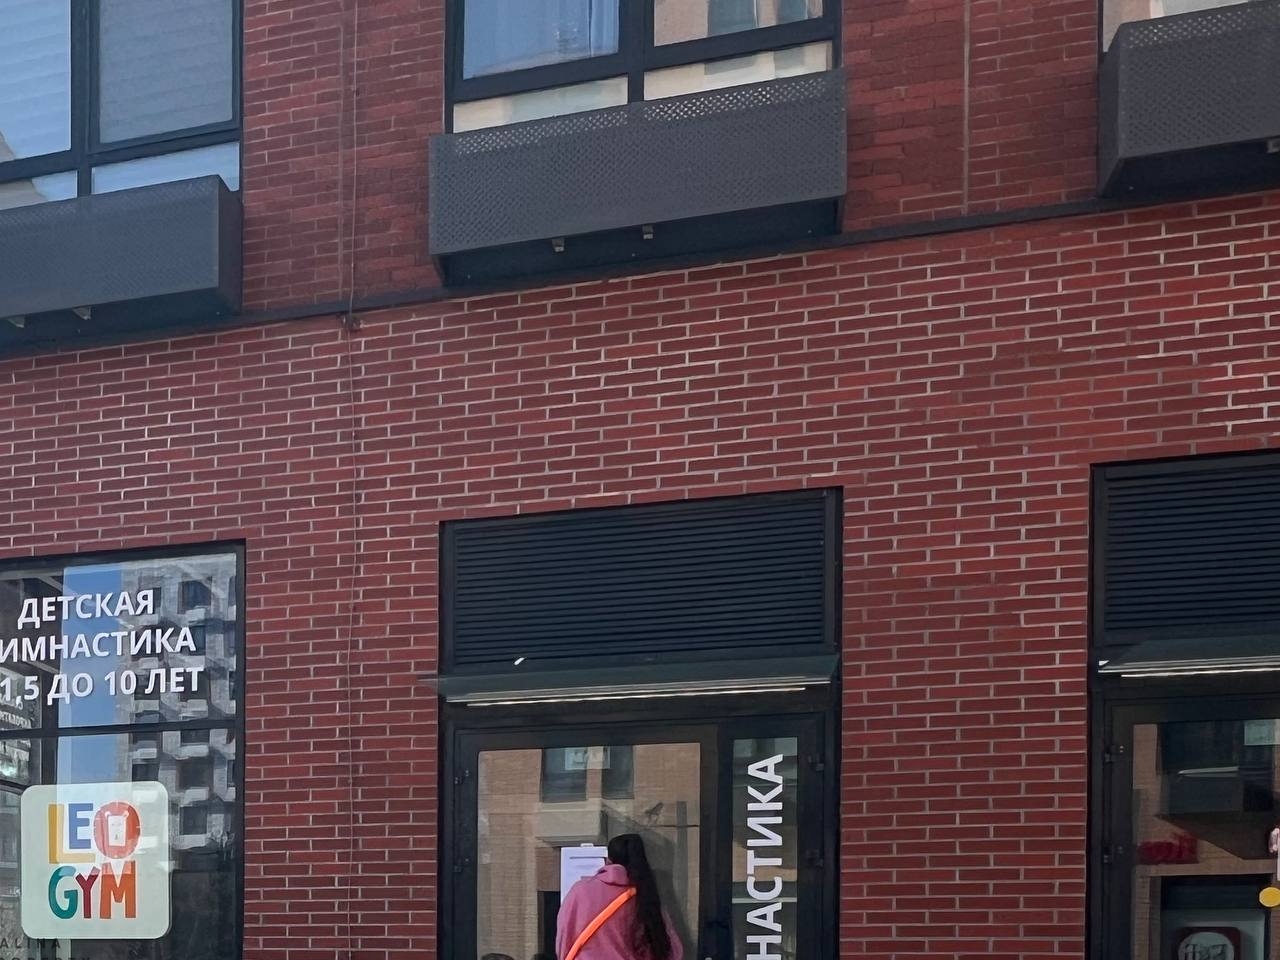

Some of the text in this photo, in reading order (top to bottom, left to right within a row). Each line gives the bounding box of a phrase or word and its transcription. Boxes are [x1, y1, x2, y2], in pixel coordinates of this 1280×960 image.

[17, 589, 154, 630] ДЕТСКАЯ
[0, 675, 40, 708] 1,5
[47, 672, 94, 705] ДО
[104, 670, 137, 696] 10
[144, 666, 205, 694] ЛЕТ
[48, 801, 141, 864] LEO
[48, 860, 137, 919] GYM
